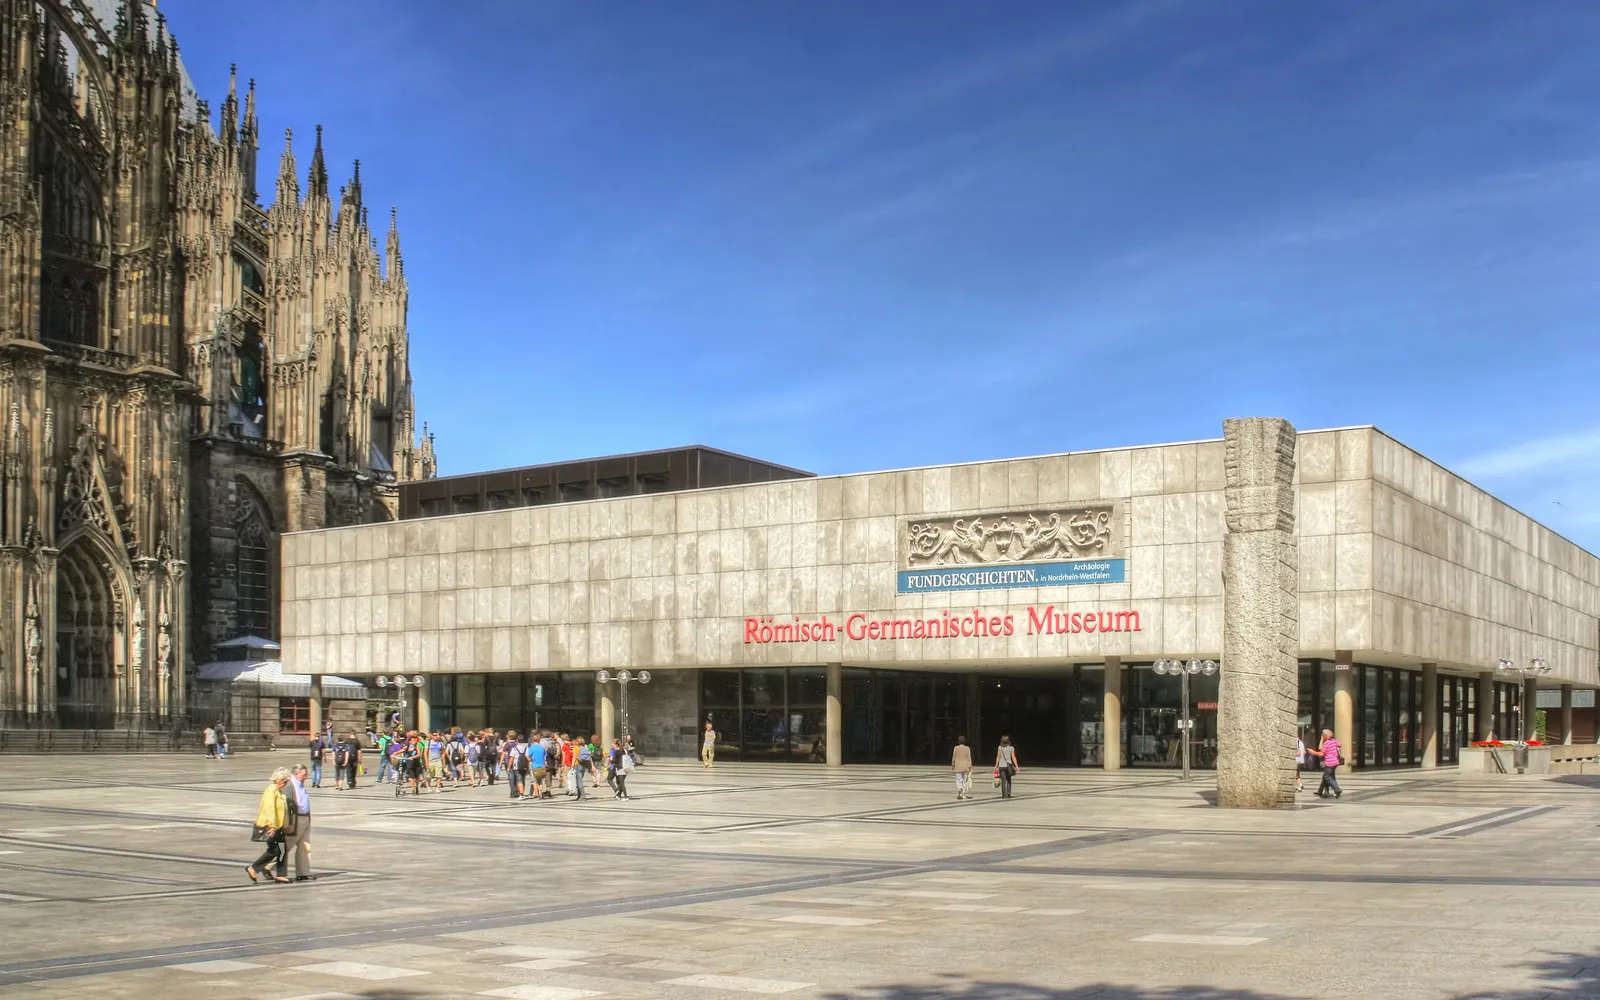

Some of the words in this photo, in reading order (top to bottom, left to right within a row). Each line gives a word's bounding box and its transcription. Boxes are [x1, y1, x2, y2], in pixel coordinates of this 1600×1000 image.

[1073, 562, 1110, 571] Archäologie
[907, 569, 1038, 588] FUNDGESCHICHTEN.
[1047, 572, 1110, 581] Nordrhein-Westfalen
[744, 609, 1015, 644] Römisch-Germanisches
[1027, 605, 1142, 635] Museum
